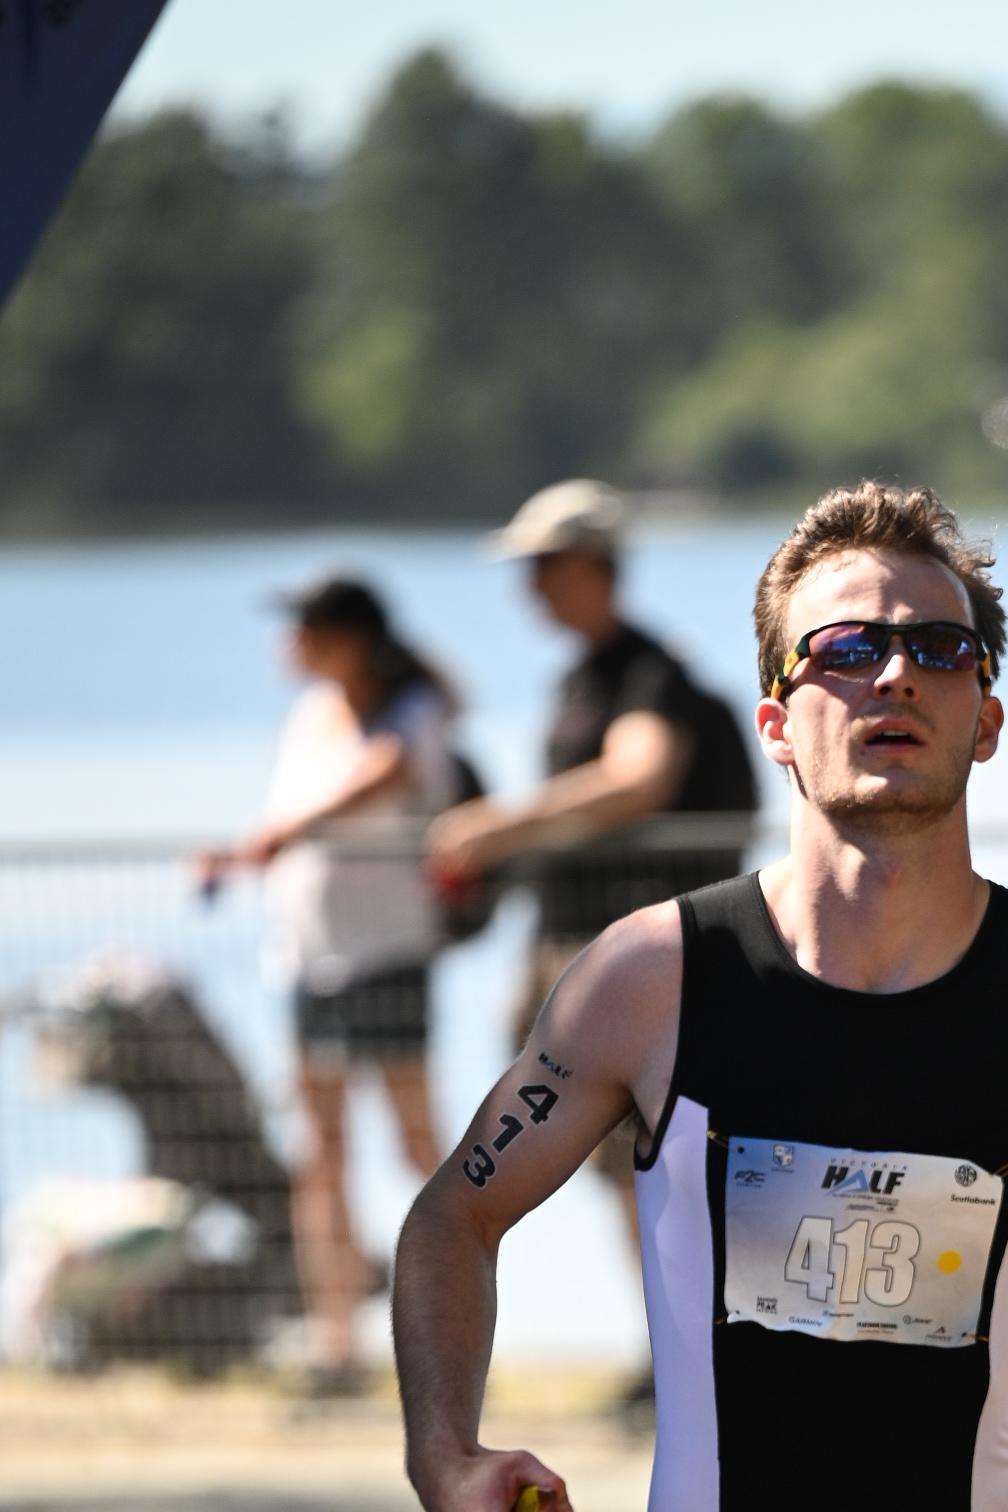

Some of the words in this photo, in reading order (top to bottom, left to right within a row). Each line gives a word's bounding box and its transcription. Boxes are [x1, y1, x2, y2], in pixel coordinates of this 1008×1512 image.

[463, 1083, 559, 1188] 413
[821, 1164, 906, 1196] HALF
[950, 1194, 996, 1206] Scotiabank
[783, 1215, 921, 1308] 413
